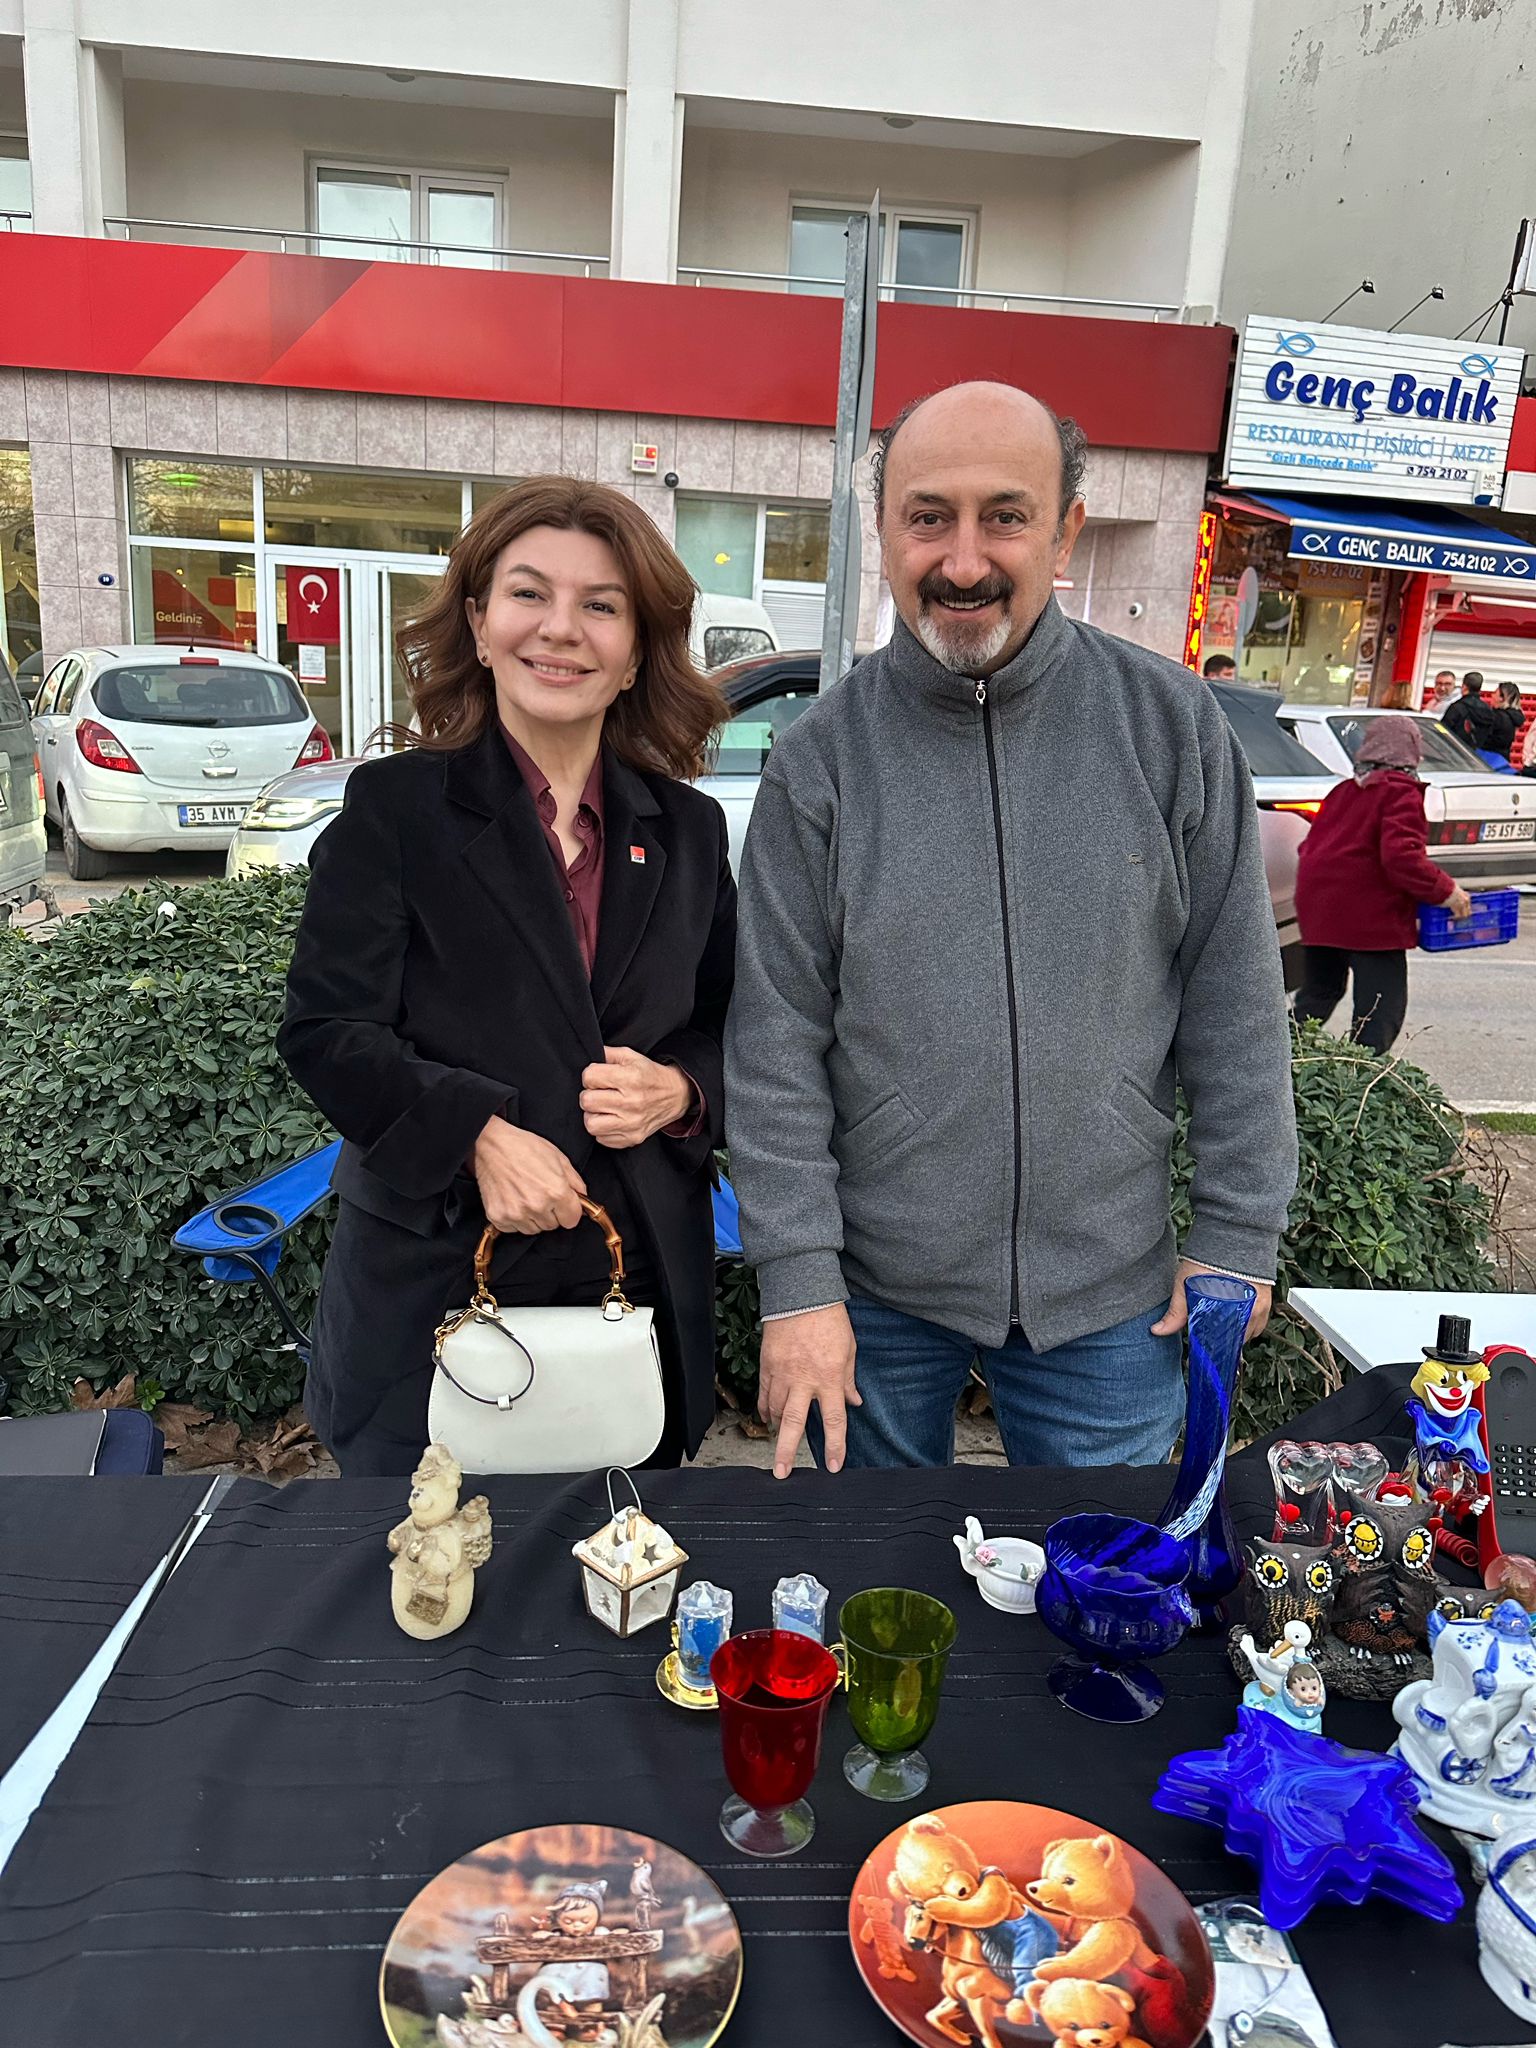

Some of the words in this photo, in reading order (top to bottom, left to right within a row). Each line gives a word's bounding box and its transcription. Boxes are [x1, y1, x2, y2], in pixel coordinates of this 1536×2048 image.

[1265, 361, 1375, 423] Genç
[1387, 373, 1499, 424] Balık
[1247, 423, 1359, 450] RESTAURANT
[1374, 432, 1436, 460] PİŞİRİCİ
[1451, 443, 1497, 463] MEZE
[1417, 465, 1436, 478] 754
[1439, 467, 1452, 479] 21
[1454, 469, 1468, 480] 02
[1338, 536, 1381, 560] GENÇ
[1386, 541, 1435, 565] BALIK
[155, 611, 203, 625] Geldiniz
[188, 807, 205, 821] 35
[1485, 824, 1497, 838] 35
